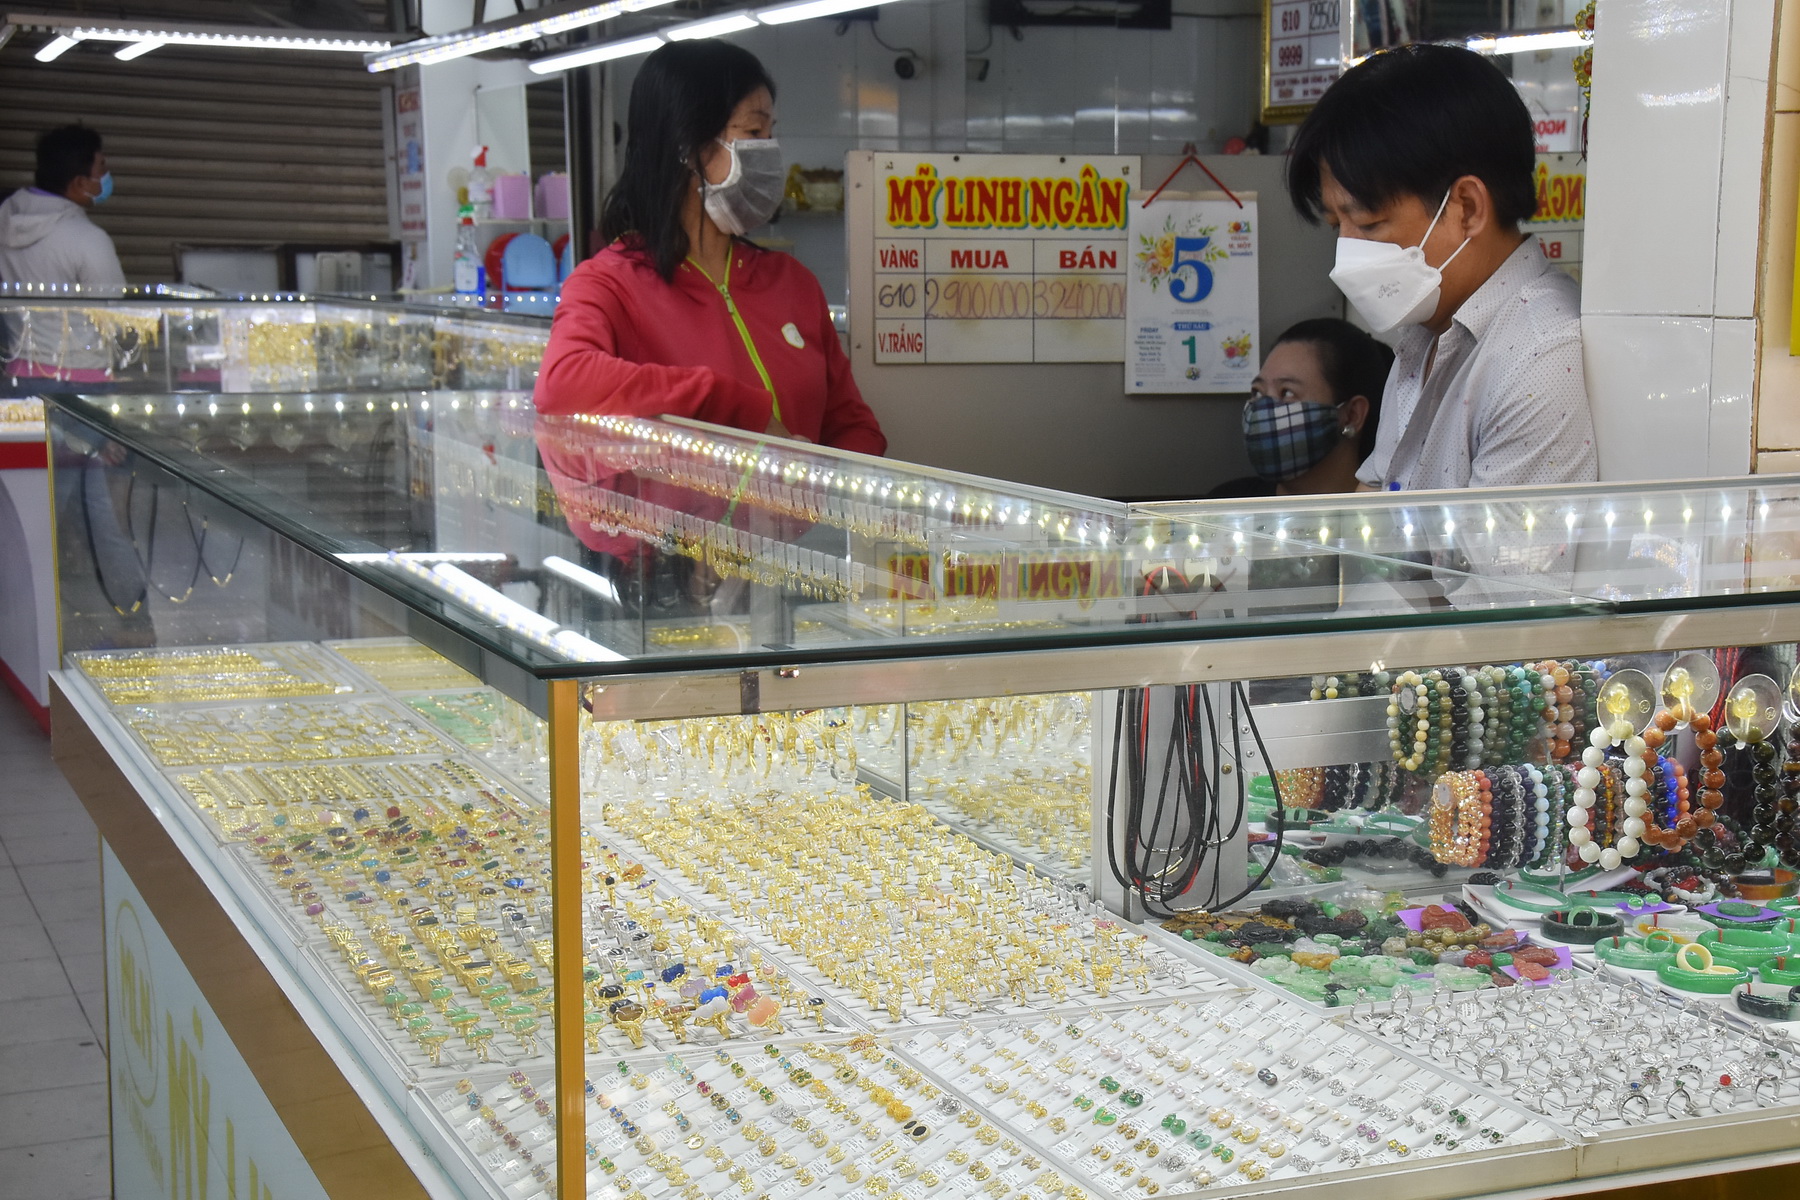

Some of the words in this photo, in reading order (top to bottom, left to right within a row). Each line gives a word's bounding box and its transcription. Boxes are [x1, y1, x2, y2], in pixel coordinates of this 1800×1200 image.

[1282, 9, 1300, 32] 610
[887, 165, 938, 225] MỸ
[944, 178, 1024, 224] LINH
[1028, 166, 1124, 225] NGÂN
[880, 245, 918, 268] VÀNG
[951, 250, 1009, 269] MUA
[1059, 246, 1117, 269] BÁN
[1169, 236, 1213, 303] 5
[878, 283, 916, 308] 610
[1182, 336, 1196, 364] 1
